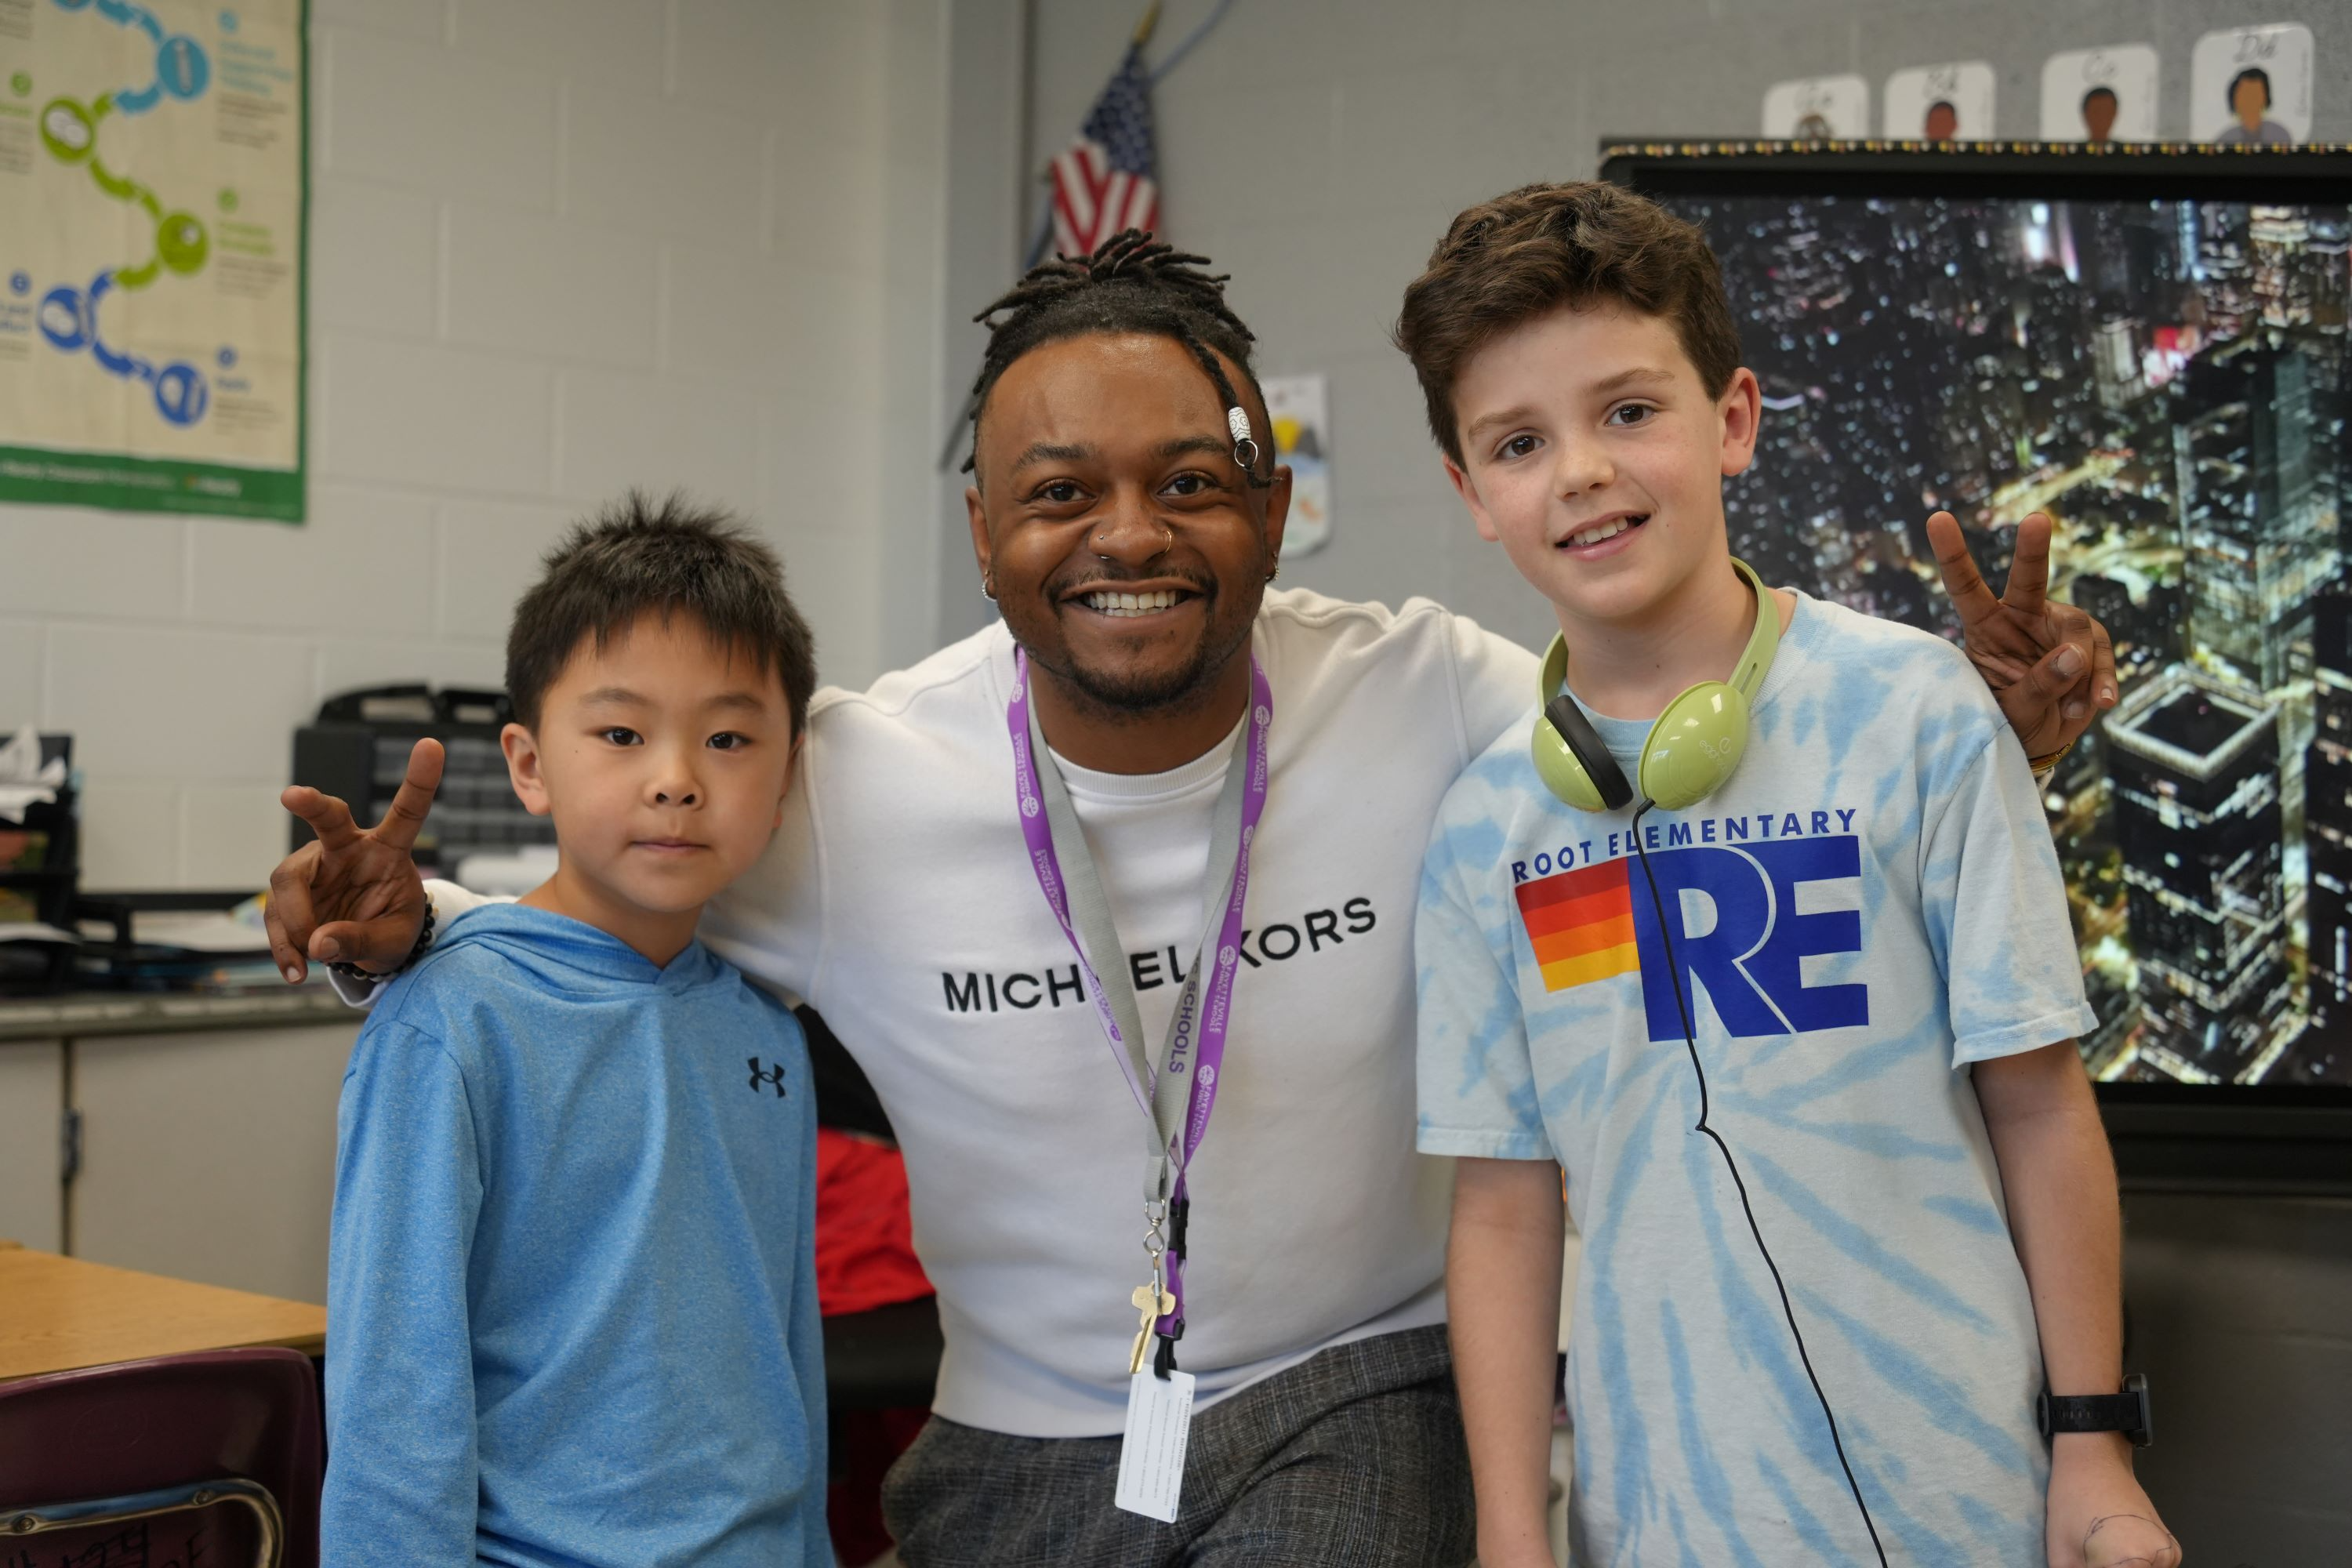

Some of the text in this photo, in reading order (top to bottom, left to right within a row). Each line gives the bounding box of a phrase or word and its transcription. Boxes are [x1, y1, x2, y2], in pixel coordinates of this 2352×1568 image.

[1512, 808, 1857, 884] ROOT ELEMENTARY
[1636, 835, 1869, 1043] RE
[942, 945, 1187, 1013] MICHEL
[1209, 966, 1226, 1033] PUBLIC SCHOOLS
[1215, 966, 1233, 1034] FAYETTEVILLE
[1169, 981, 1196, 1073] SCHOOLS
